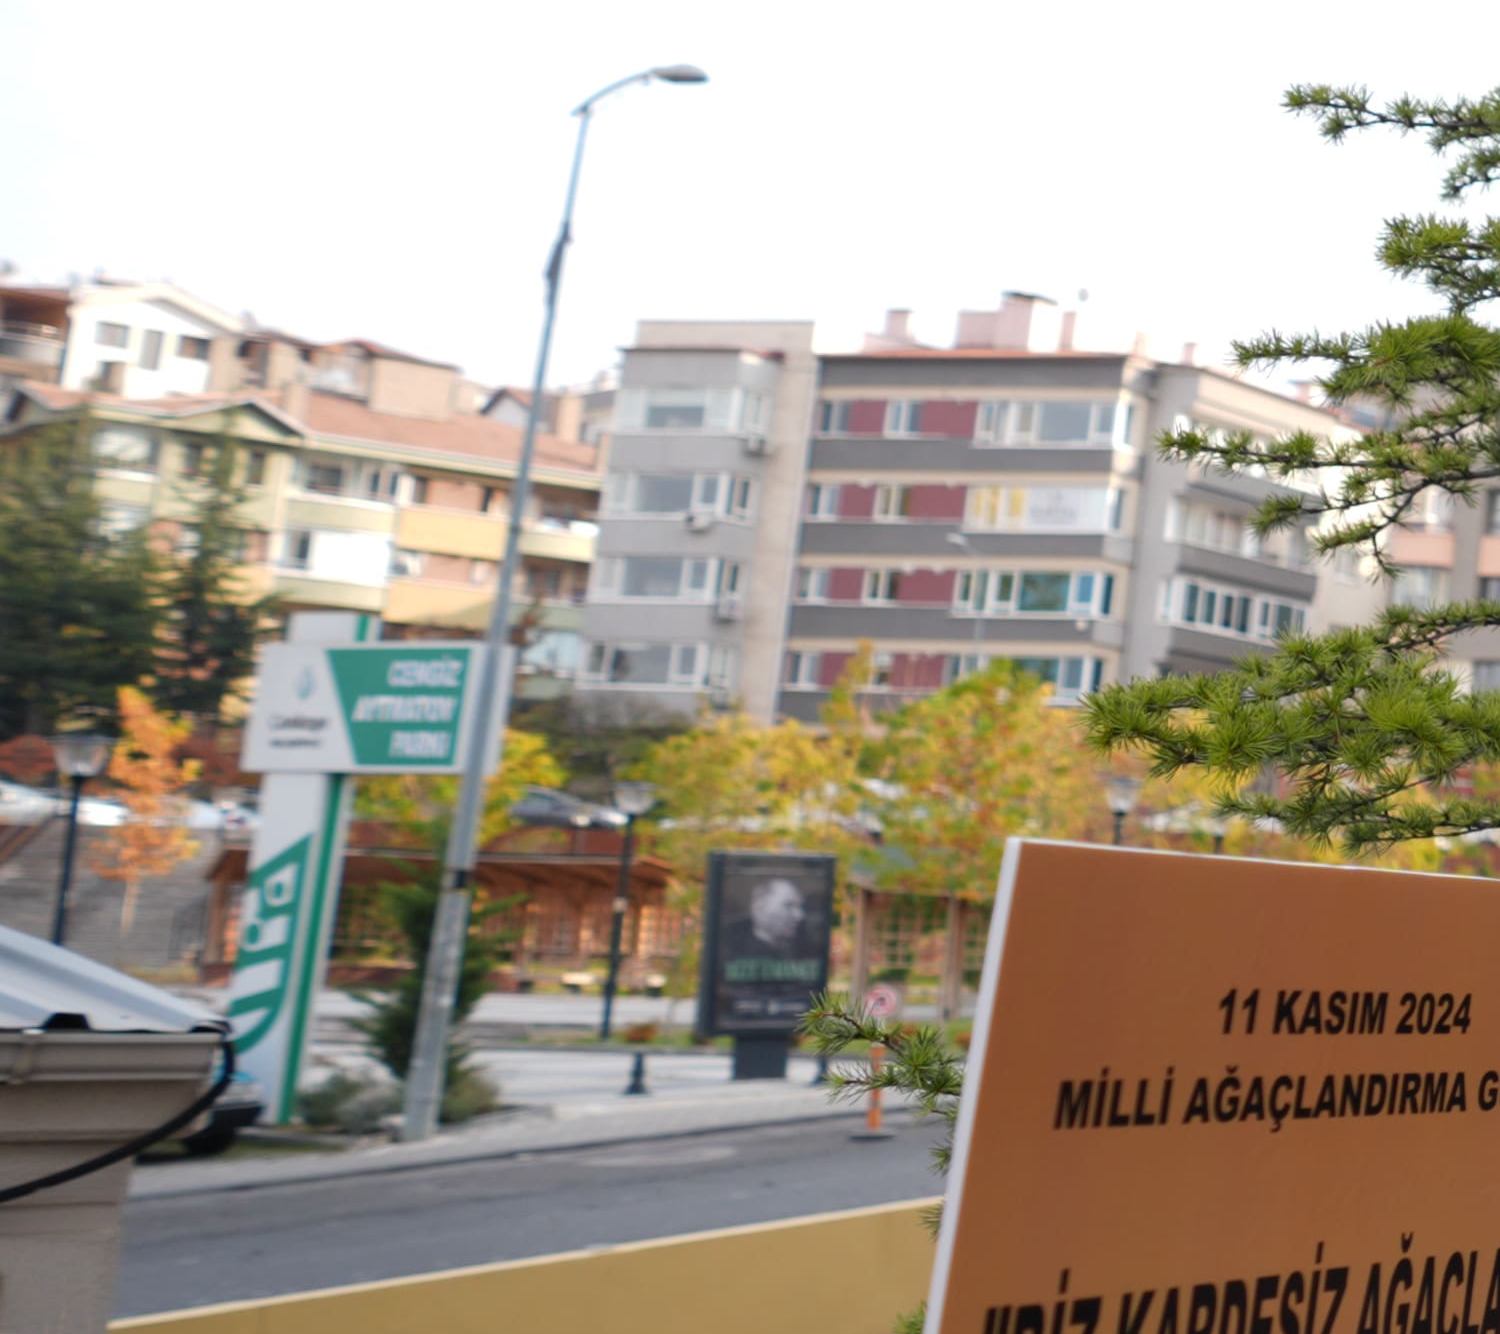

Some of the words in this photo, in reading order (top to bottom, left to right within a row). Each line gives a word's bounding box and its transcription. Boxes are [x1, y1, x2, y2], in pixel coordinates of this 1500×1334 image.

[1218, 988, 1260, 1035] 11
[1272, 990, 1388, 1035] KASIM
[1395, 992, 1471, 1035] 2024
[1053, 1066, 1175, 1130] MİLLİ
[1182, 1065, 1467, 1133] AĞAÇLANDIRMA
